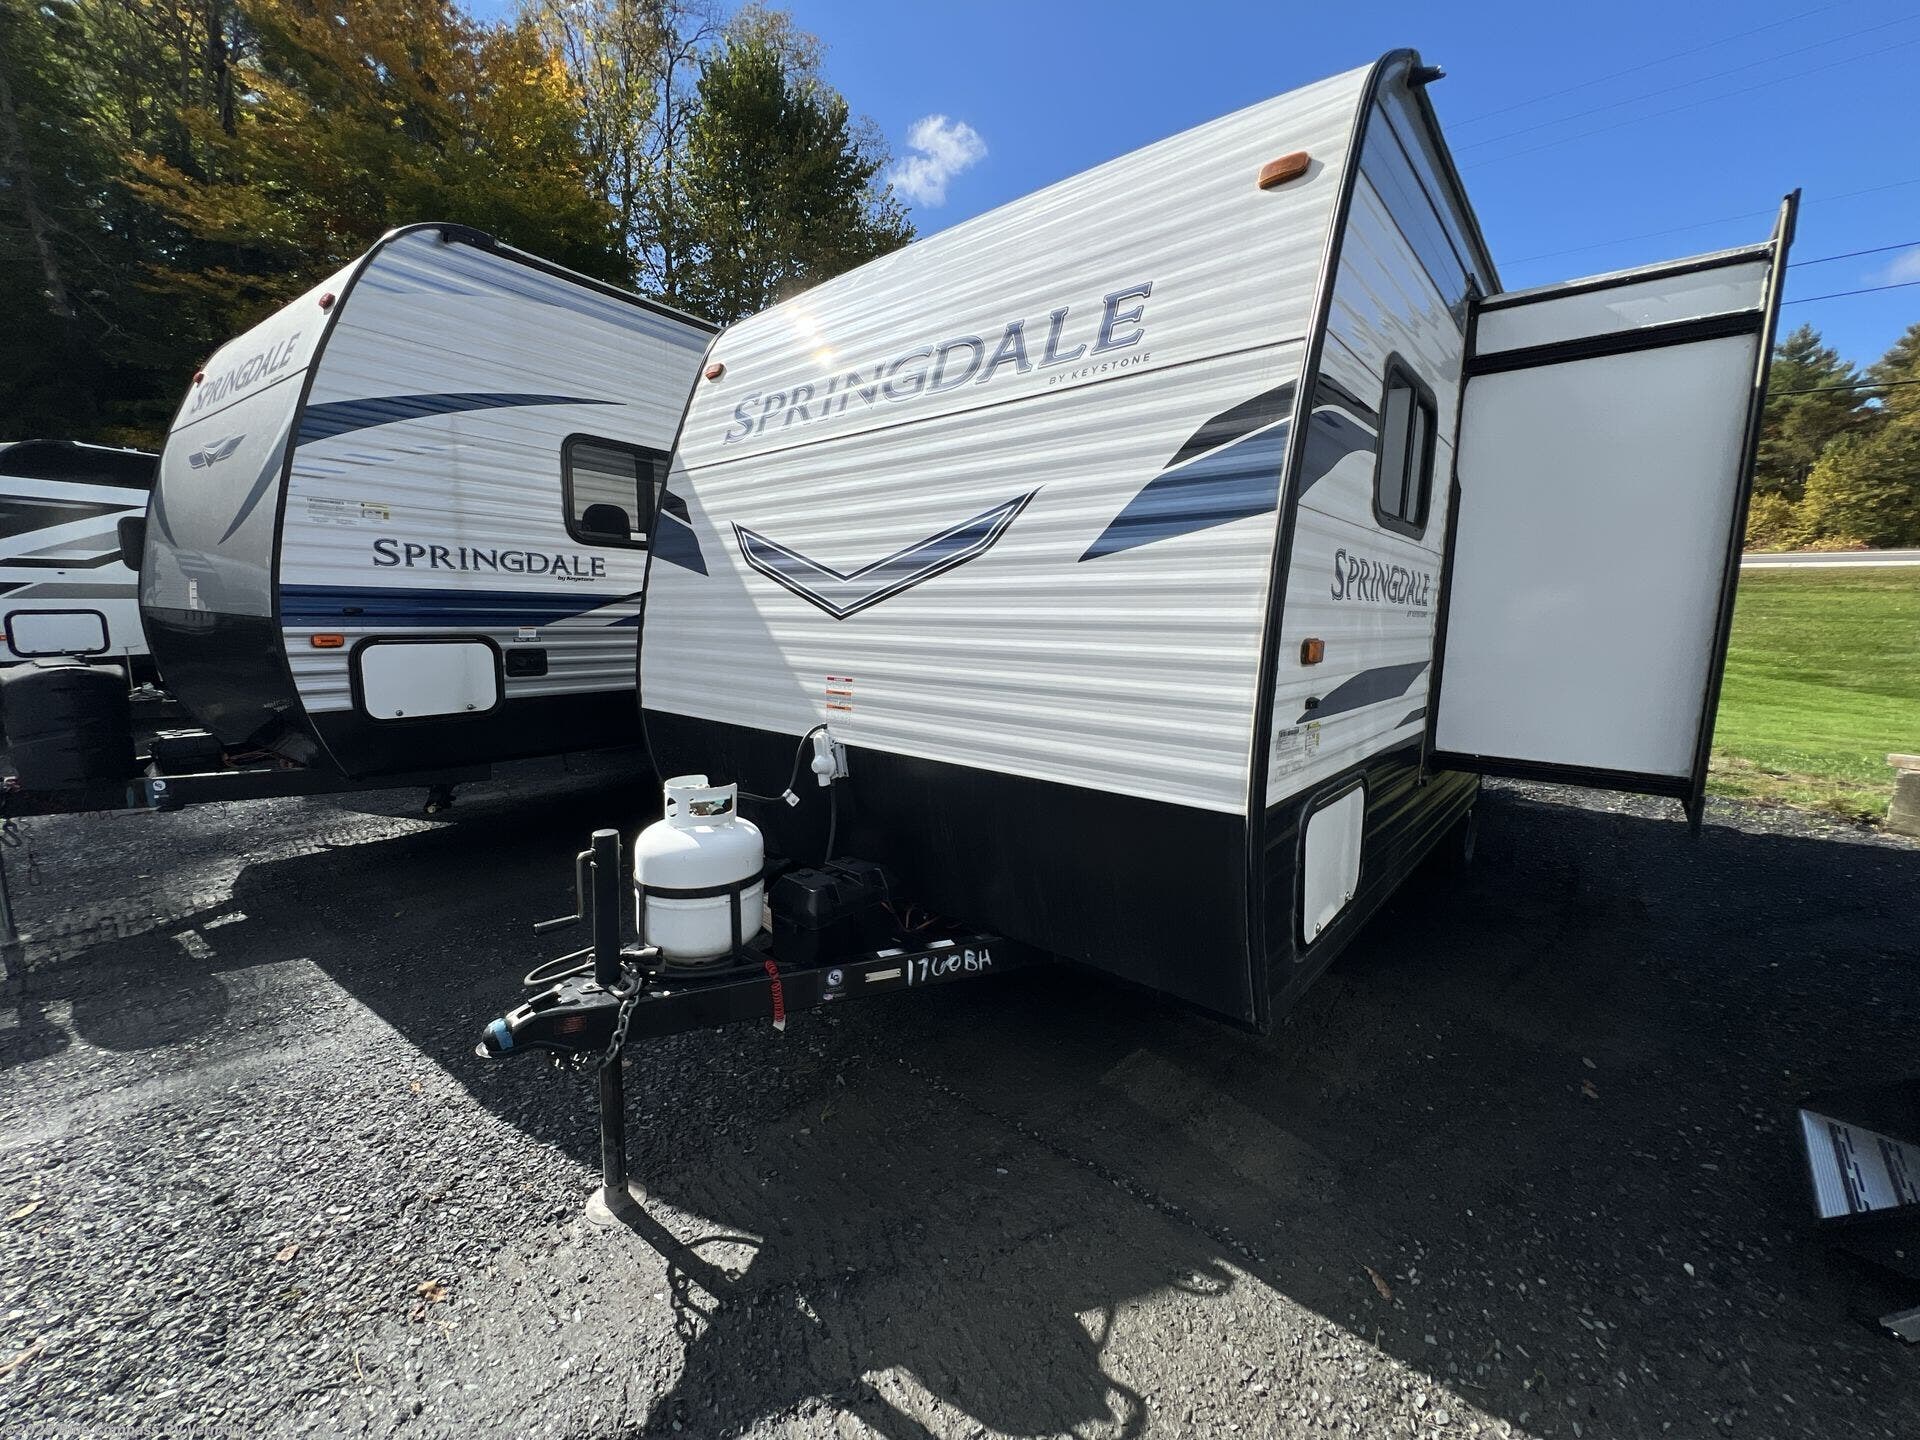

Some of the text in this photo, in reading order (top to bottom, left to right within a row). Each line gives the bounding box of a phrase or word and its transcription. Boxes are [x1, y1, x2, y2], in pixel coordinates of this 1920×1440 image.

[191, 330, 302, 414] SPRINGDALE
[723, 281, 1155, 445] SPRINGDALE
[1049, 352, 1152, 385] BY KEYSTONE
[372, 537, 607, 578] SPRINGDALE
[1331, 547, 1430, 607] SPRINGDALE
[907, 948, 992, 986] 1760BH
